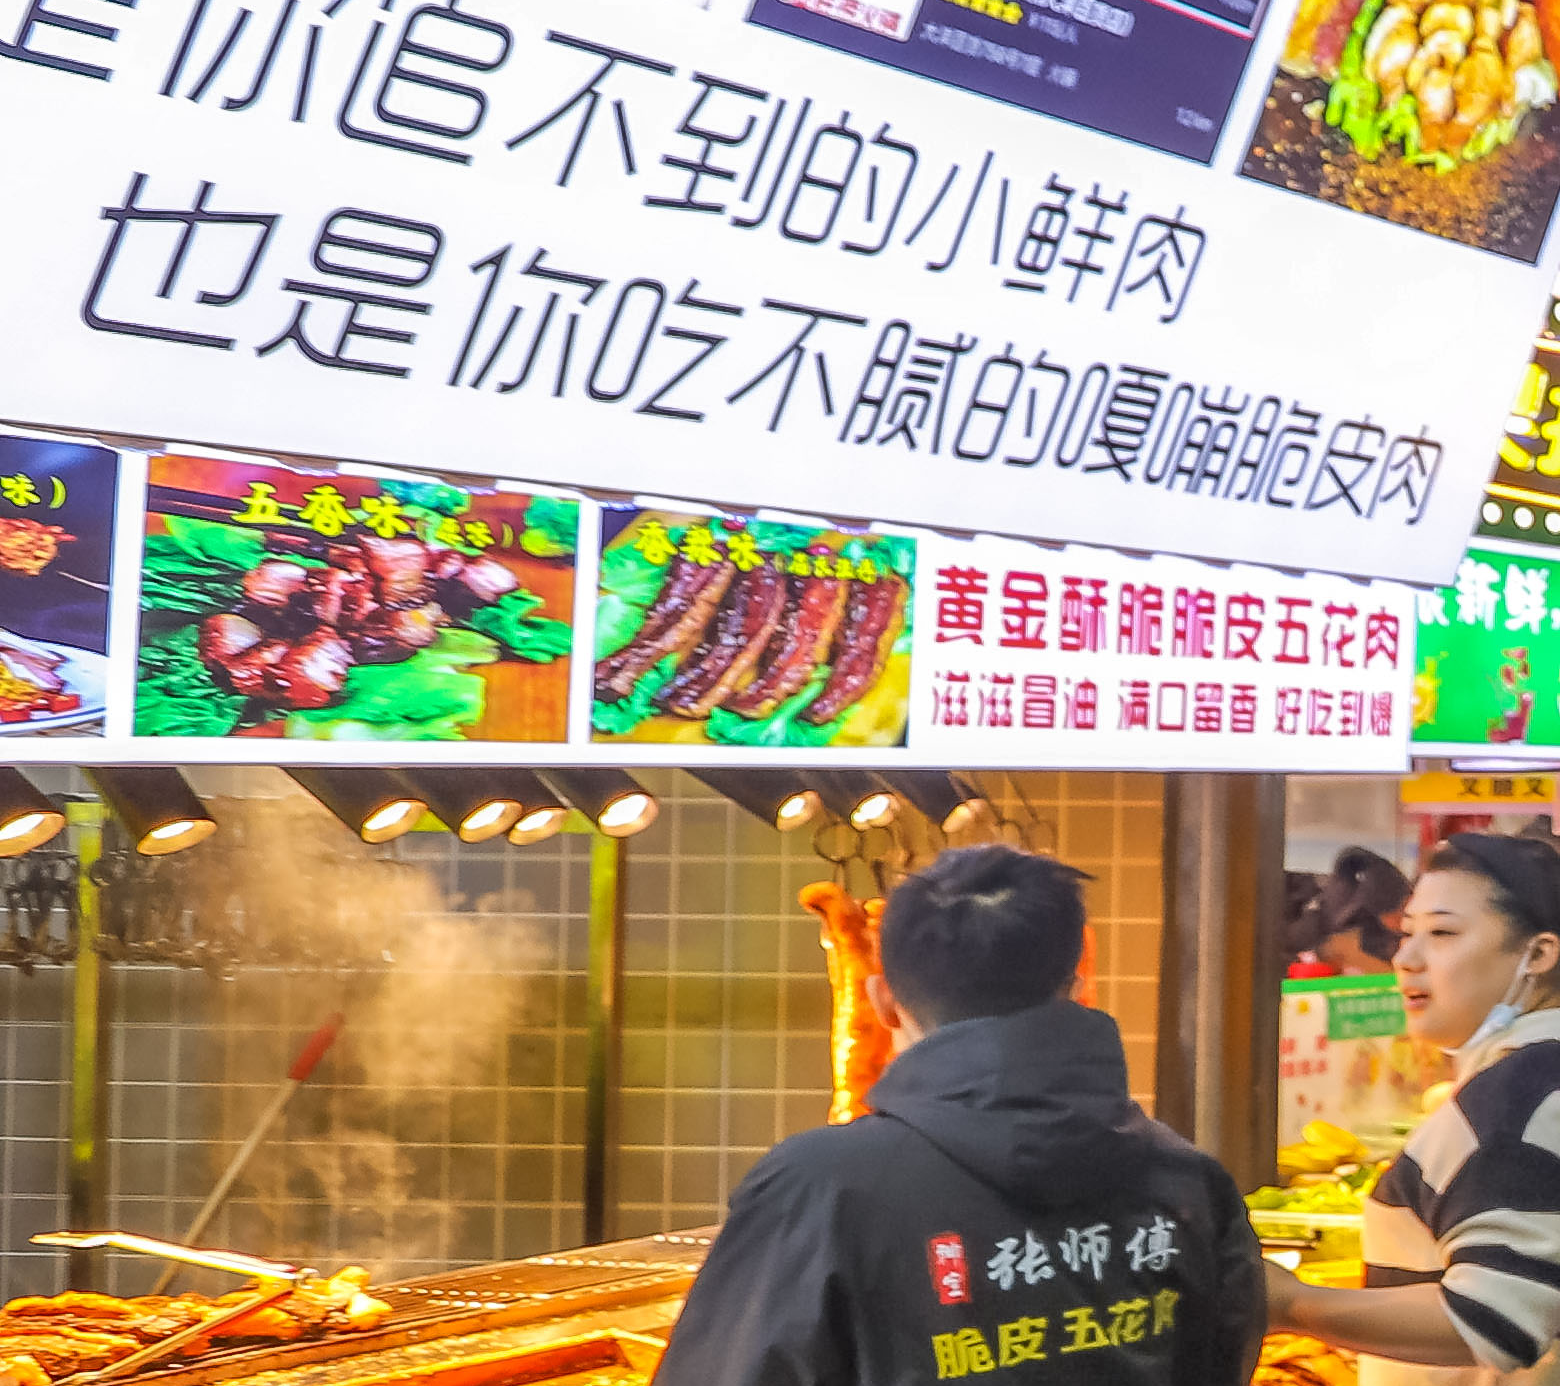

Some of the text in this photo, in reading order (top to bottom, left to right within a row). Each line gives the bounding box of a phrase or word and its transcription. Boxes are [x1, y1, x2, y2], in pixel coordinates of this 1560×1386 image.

[80, 169, 1446, 529] 也是你吃不腻的嘎嘣脆皮肉
[229, 477, 416, 541] 五香味
[934, 563, 1402, 671] 黄金酥脆脆皮五花肉
[931, 669, 1101, 732] 滋滋冒油
[1116, 679, 1259, 735] 满口留香
[985, 1214, 1183, 1292] 张师傅
[931, 1287, 1181, 1381] 脆皮五花肉
